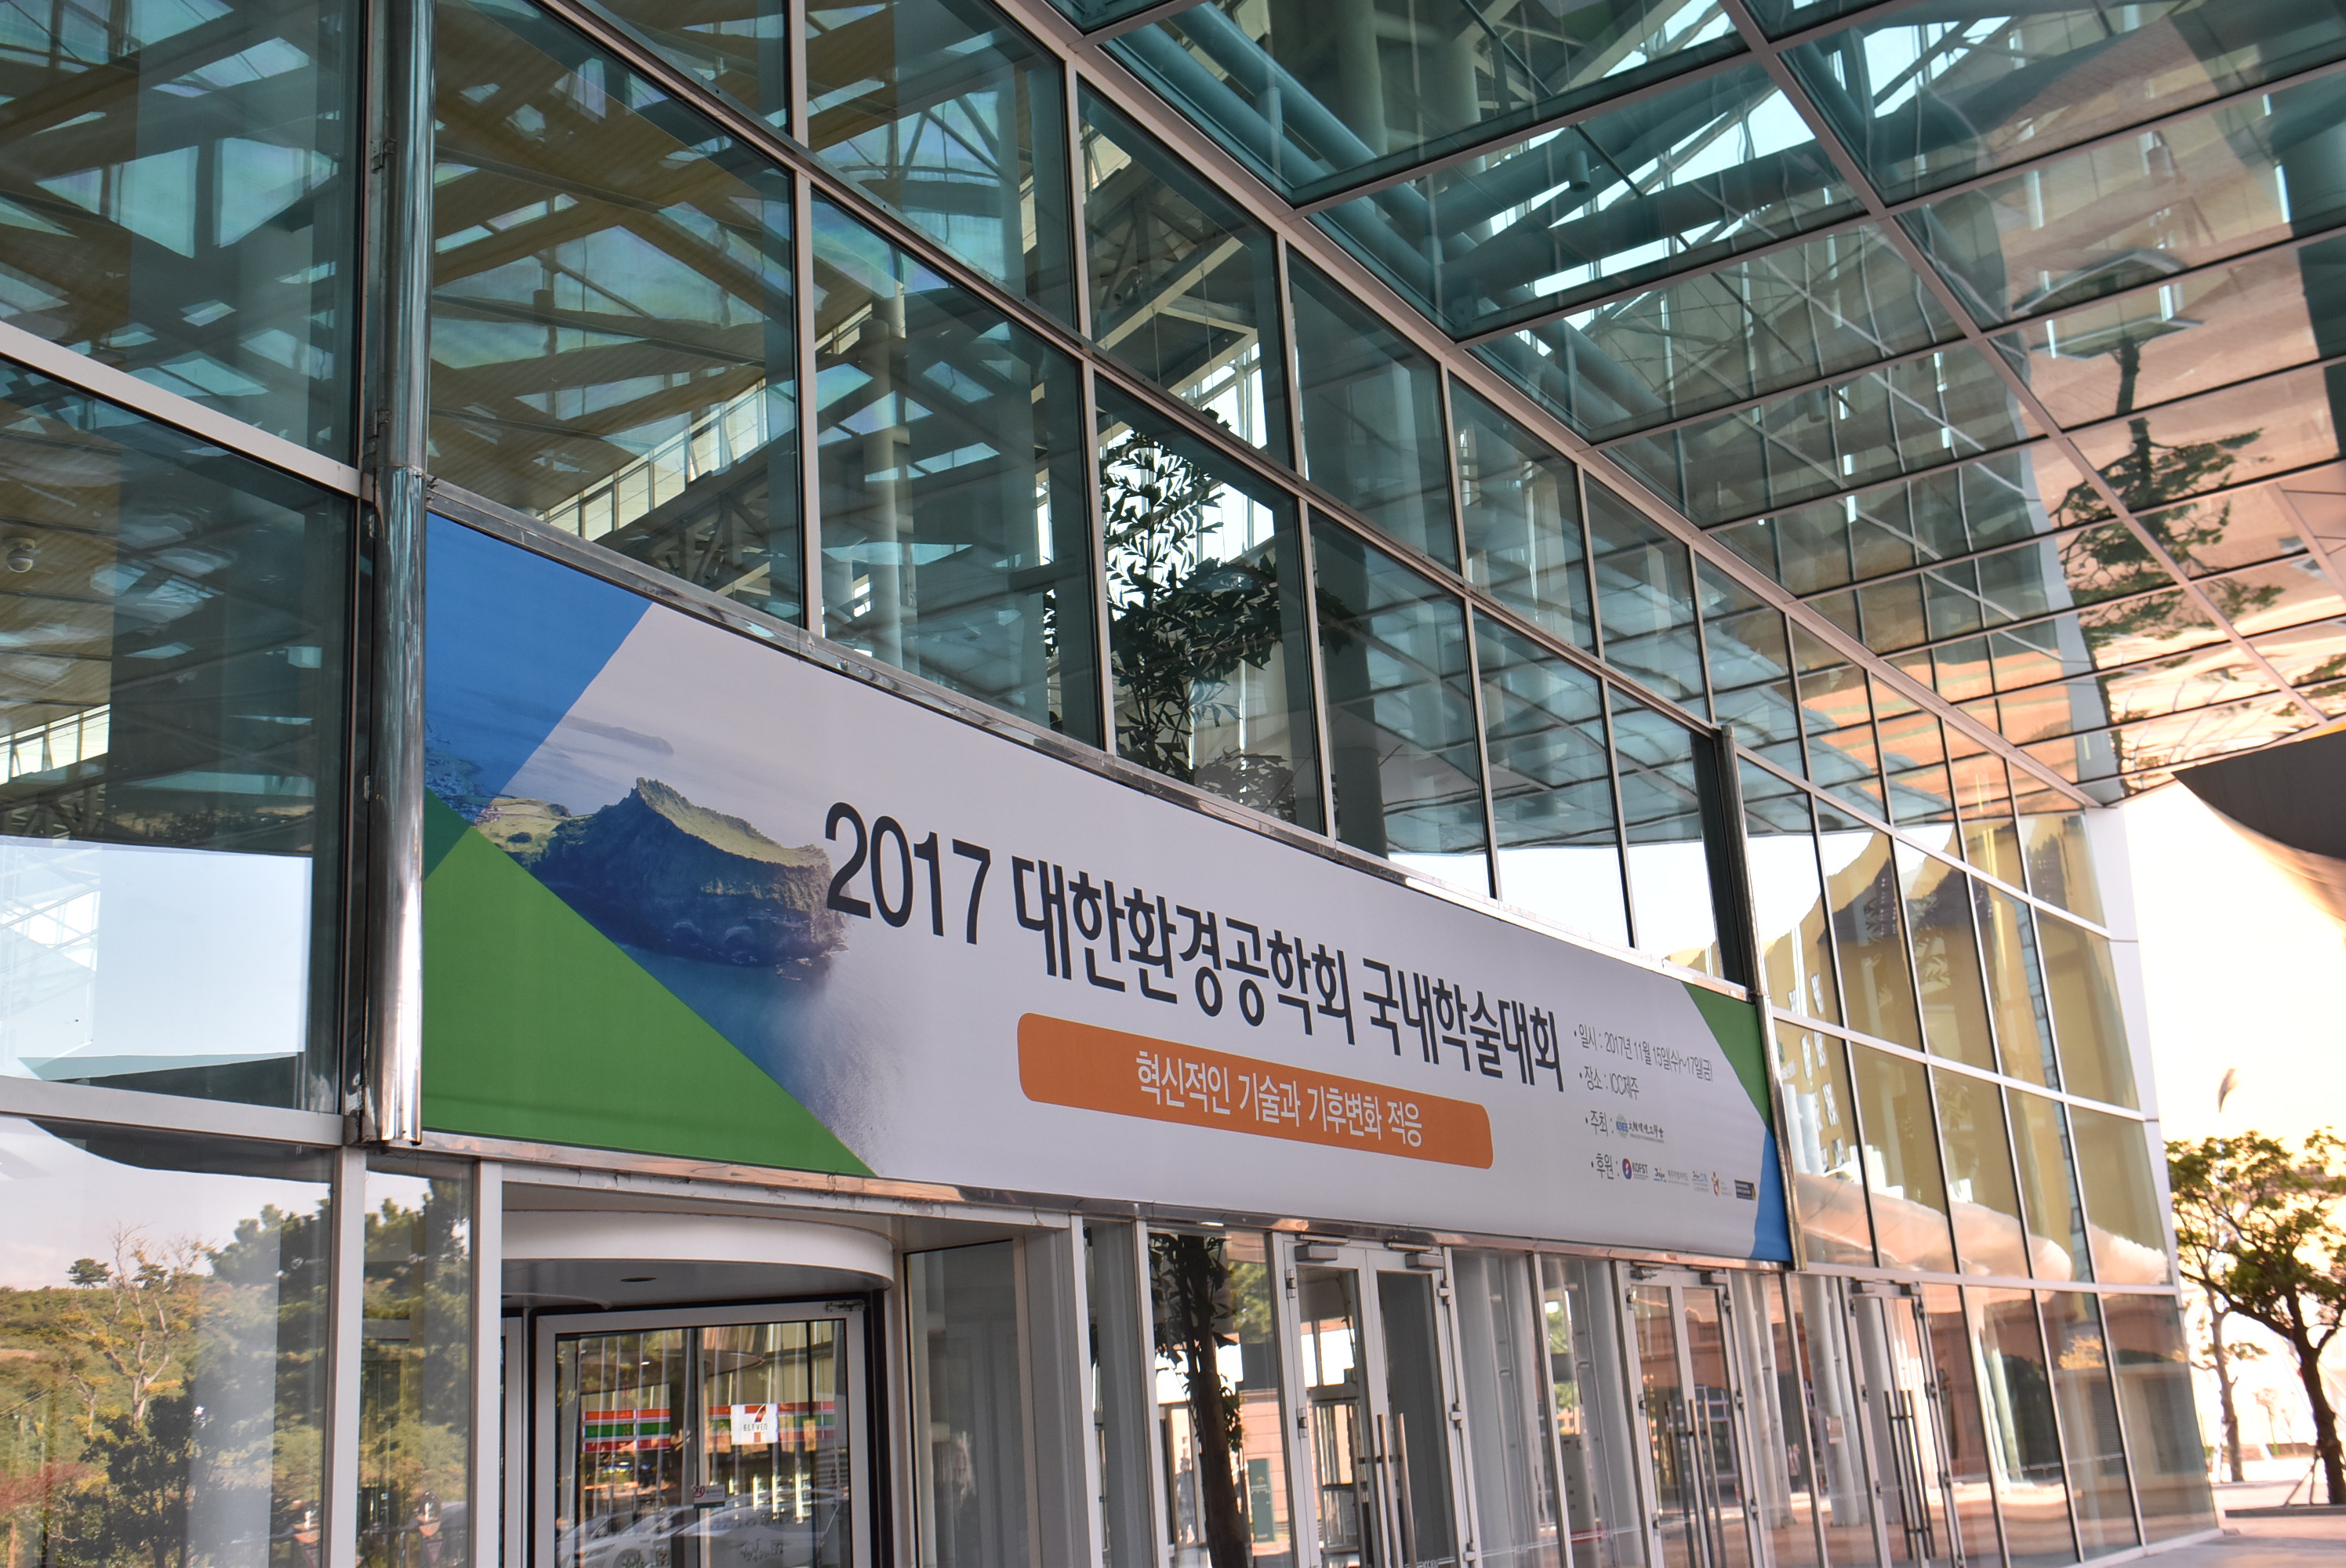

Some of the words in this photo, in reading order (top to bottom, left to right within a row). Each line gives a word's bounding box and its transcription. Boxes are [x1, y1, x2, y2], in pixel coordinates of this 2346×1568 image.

[825, 802, 991, 946] 2017
[1011, 855, 1356, 1046] 대한환경공학회
[1363, 957, 1564, 1092] 국내학술대회
[1578, 1024, 1597, 1051] 일시
[1604, 1032, 1632, 1060] 2017년
[1634, 1041, 1652, 1065] 11월
[1136, 1051, 1230, 1116] 혁신적인
[1238, 1073, 1301, 1127] 기술과
[1307, 1086, 1382, 1140] 기후변화
[1387, 1101, 1422, 1147] 적응
[1584, 1065, 1603, 1091] 장소
[1609, 1073, 1640, 1101] ICC제주
[1590, 1110, 1608, 1137] 주최
[1596, 1153, 1614, 1180] 후원
[1632, 1162, 1648, 1174] KOFST
